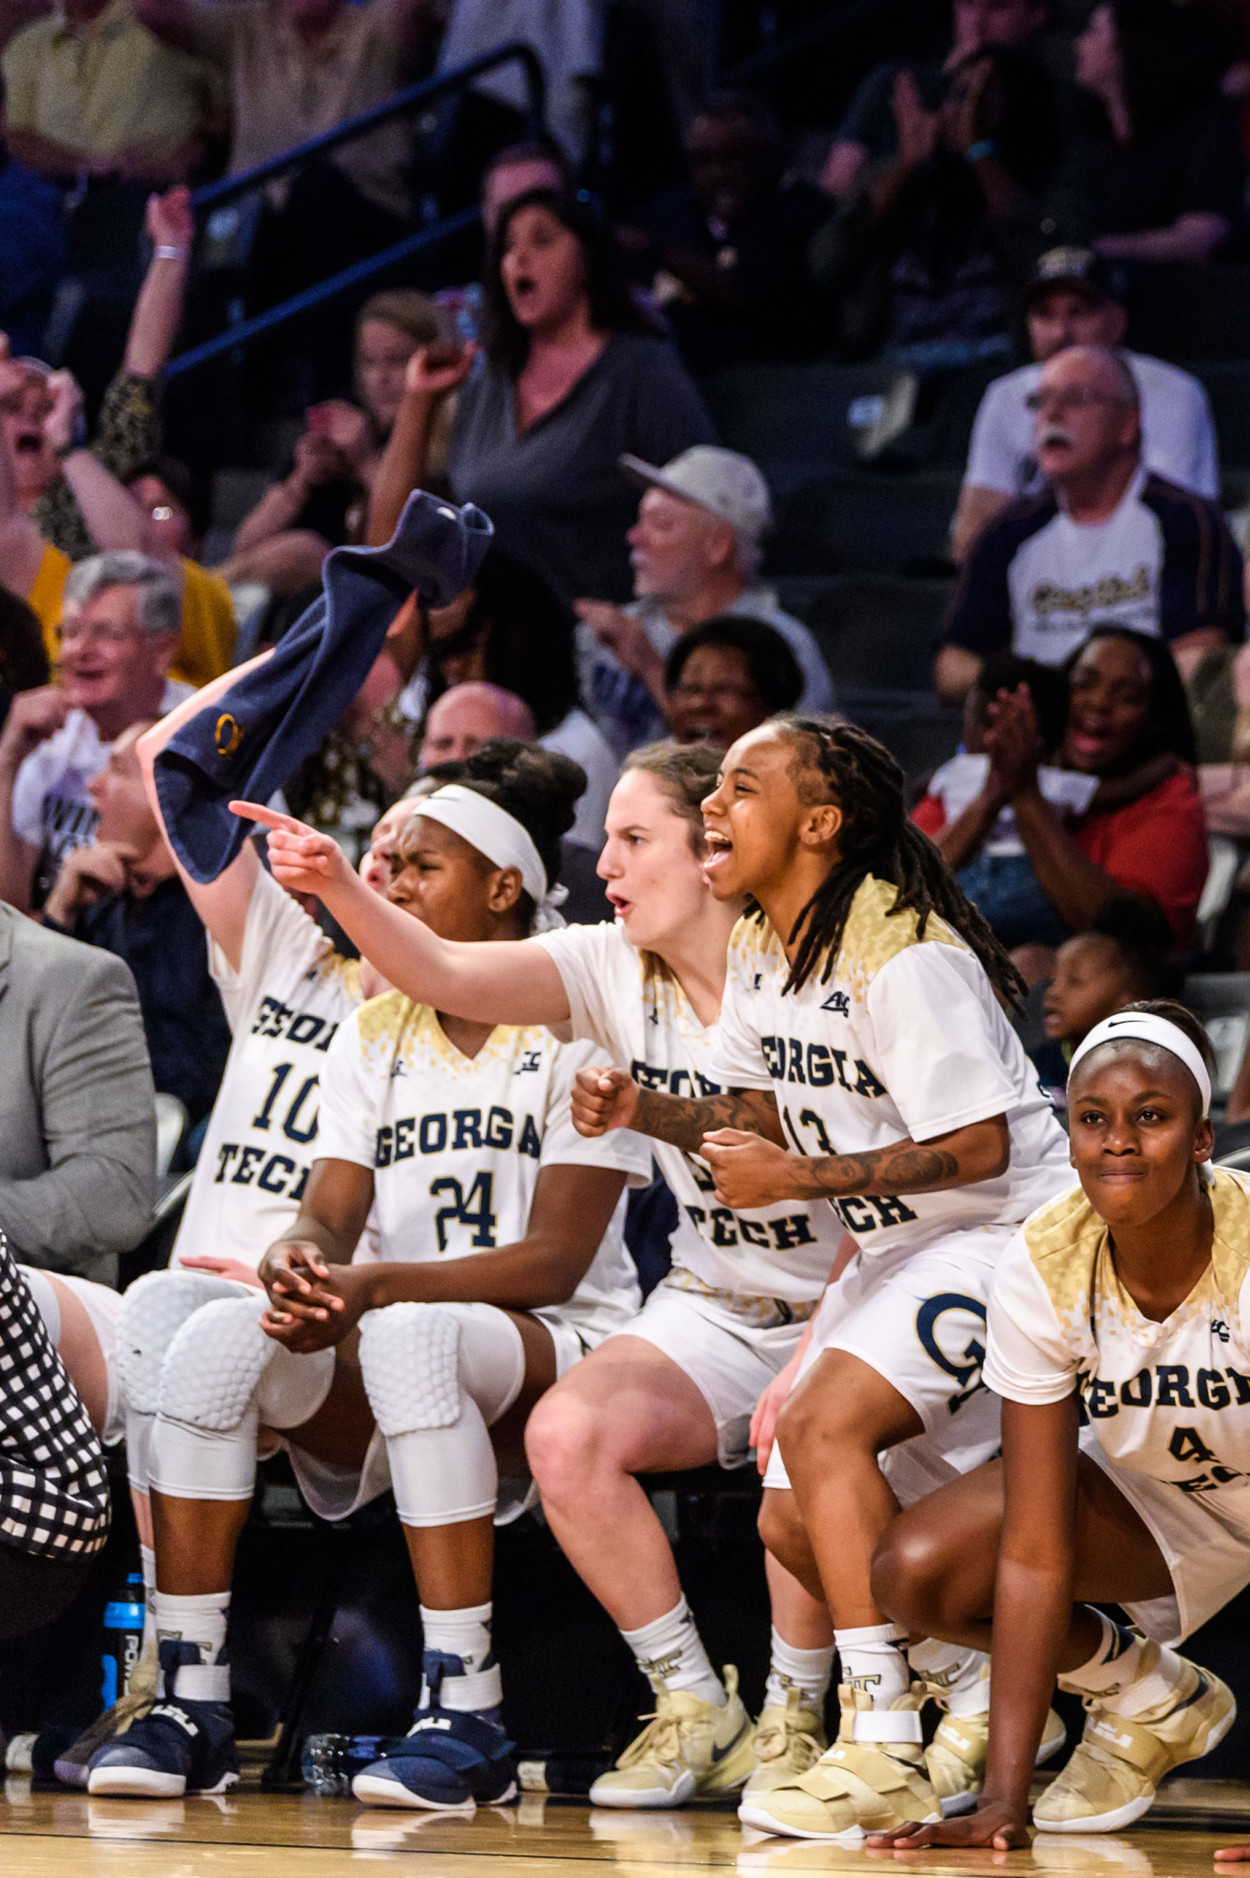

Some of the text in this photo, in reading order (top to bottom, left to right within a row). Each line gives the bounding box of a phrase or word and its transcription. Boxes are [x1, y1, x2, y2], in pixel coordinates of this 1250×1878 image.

[251, 1061, 320, 1146] 10
[429, 1170, 497, 1254] 24
[684, 1204, 818, 1250] TECH
[828, 1194, 919, 1235] CH
[1166, 1425, 1223, 1464] 4
